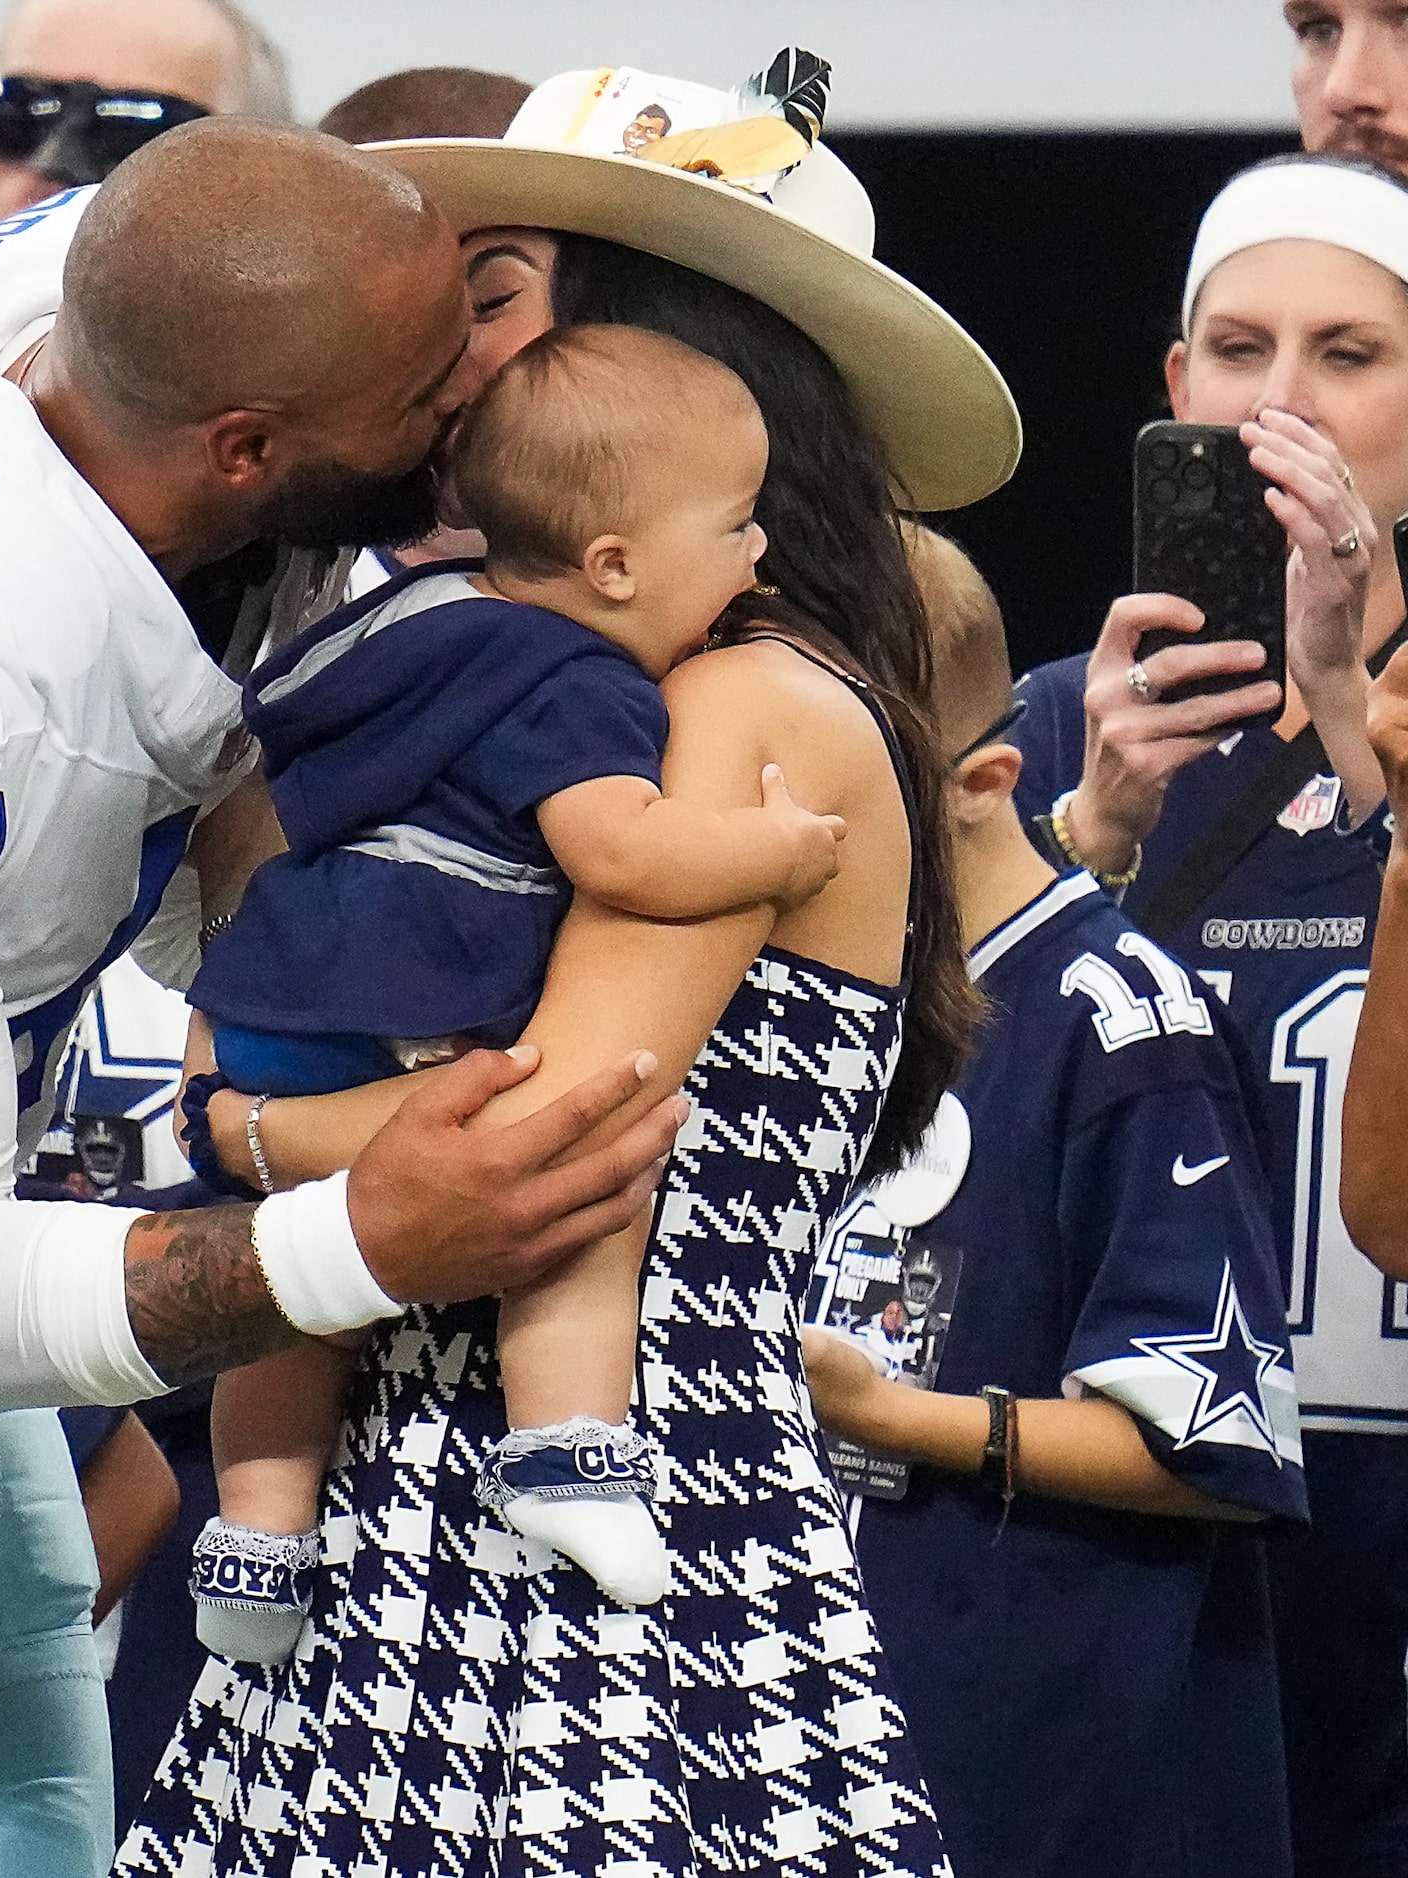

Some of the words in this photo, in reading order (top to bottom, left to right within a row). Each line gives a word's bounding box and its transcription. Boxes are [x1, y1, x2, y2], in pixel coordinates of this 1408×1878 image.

[1287, 796, 1327, 823] NFL
[1201, 915, 1366, 949] COWBOYS
[1059, 931, 1214, 1053] 11
